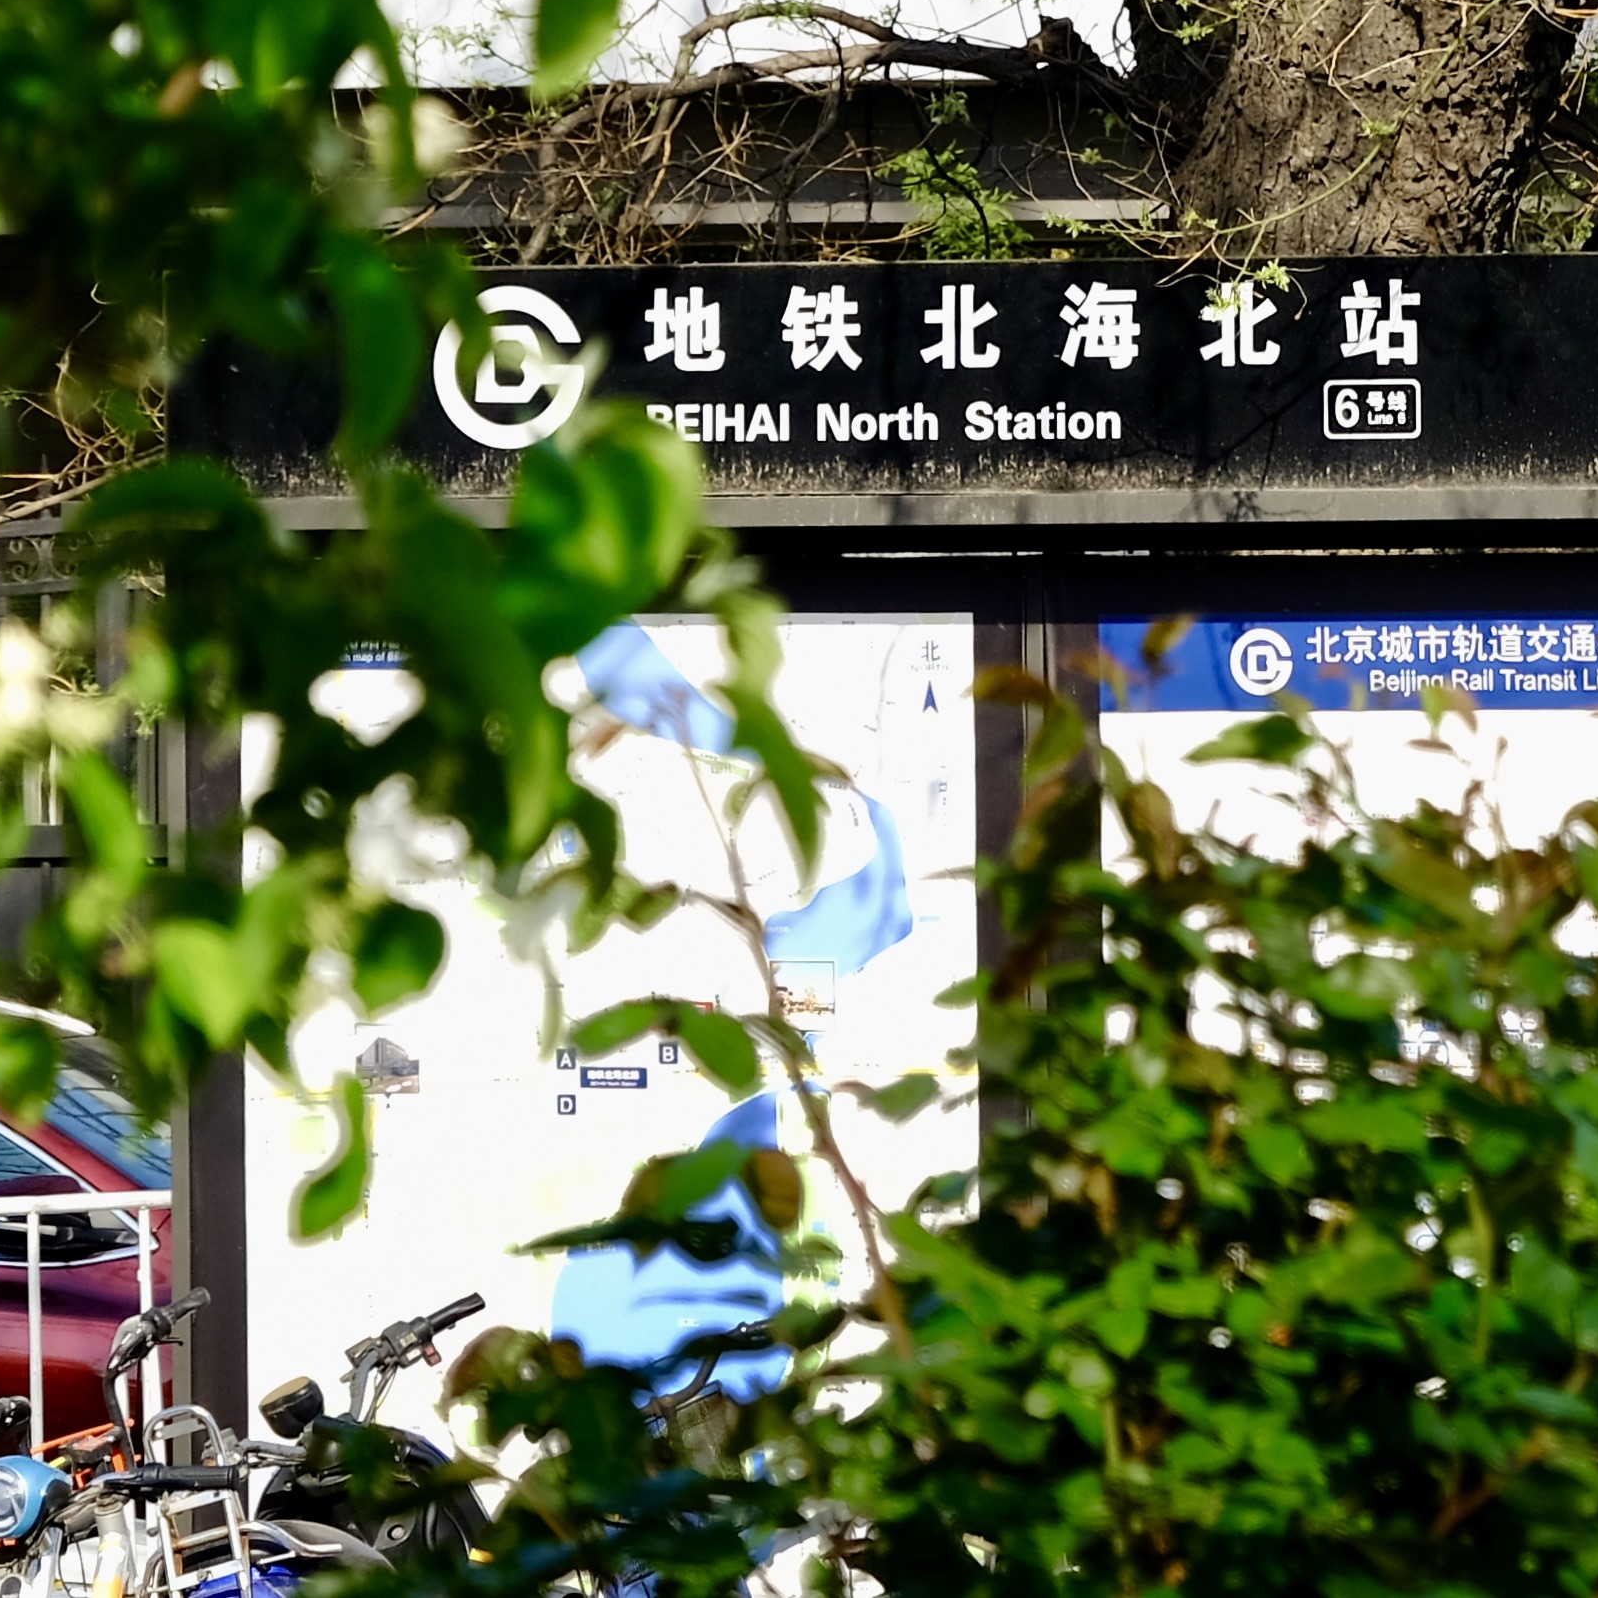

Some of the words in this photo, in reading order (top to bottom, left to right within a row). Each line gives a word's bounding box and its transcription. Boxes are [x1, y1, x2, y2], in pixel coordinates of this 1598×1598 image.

[643, 278, 1421, 372] 地铁北海北站
[816, 402, 939, 442] North
[964, 401, 1121, 442] Station
[921, 639, 941, 662] 北
[1369, 668, 1445, 699] Beijing
[1451, 667, 1495, 693] Rail
[1499, 667, 1578, 693] Transit
[559, 1052, 573, 1069] A
[662, 1045, 675, 1063] B
[559, 1096, 574, 1113] D
